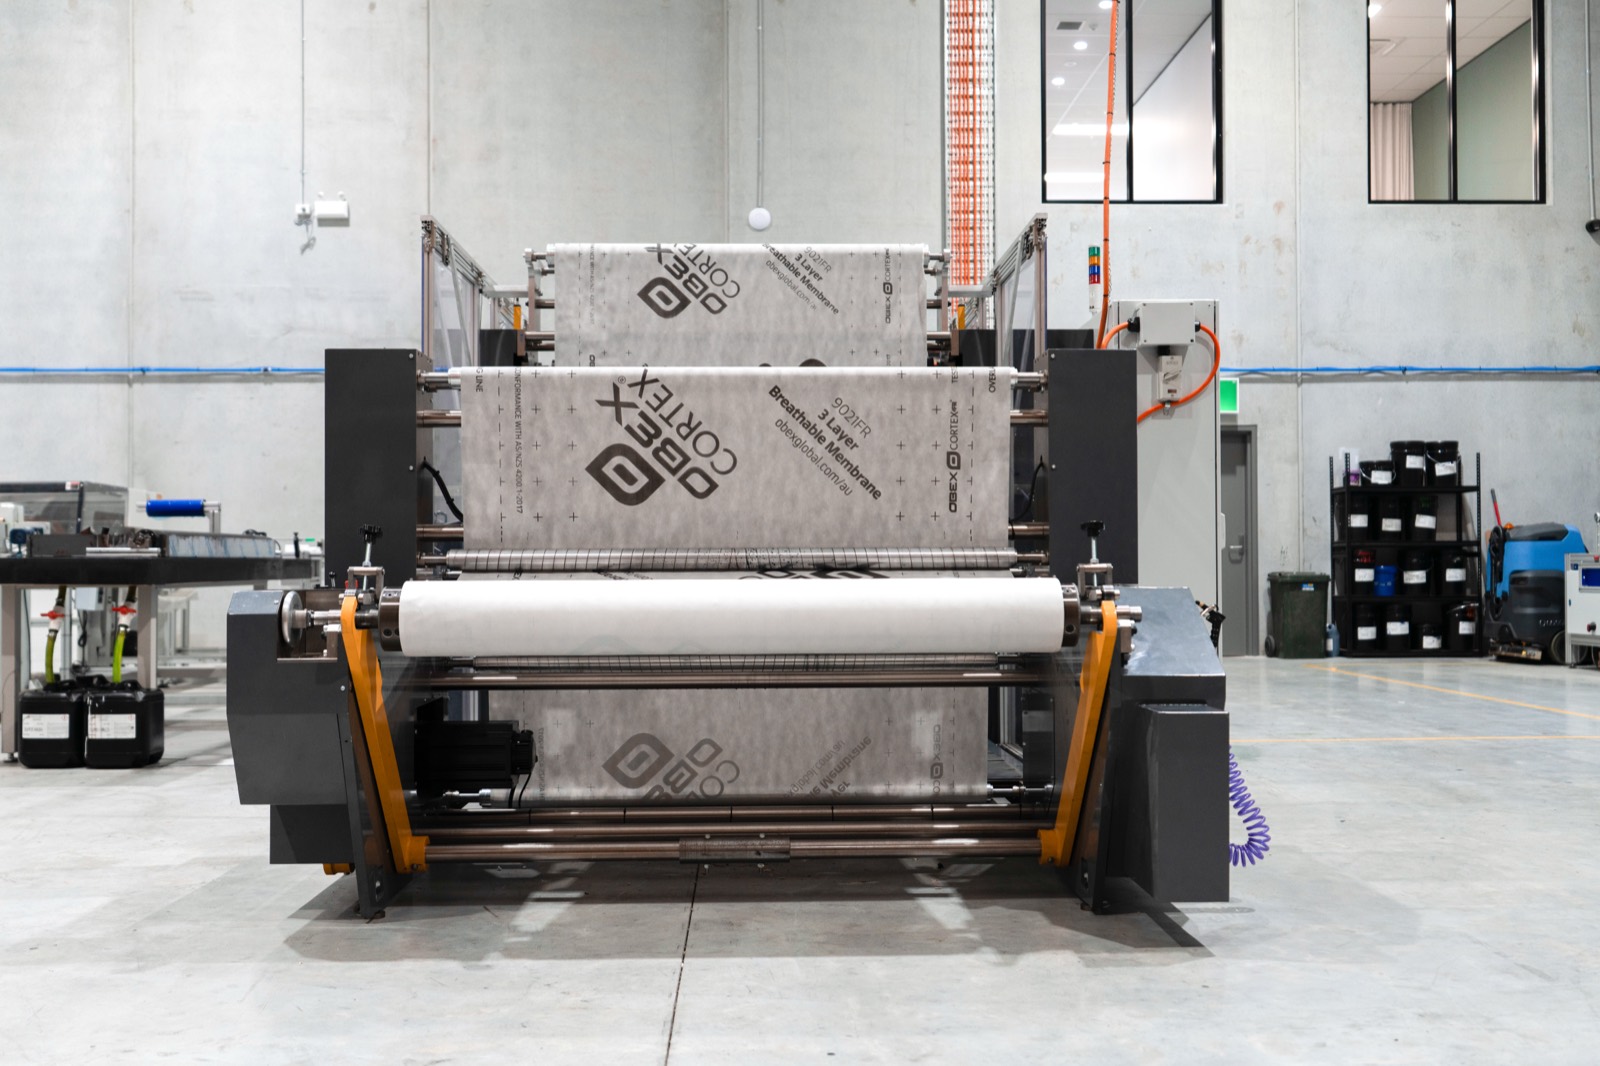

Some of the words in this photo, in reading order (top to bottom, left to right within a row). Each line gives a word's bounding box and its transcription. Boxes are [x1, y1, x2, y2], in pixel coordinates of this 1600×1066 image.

[644, 243, 728, 315] OBEX
[674, 243, 741, 299] CORTE
[793, 252, 803, 262] 3
[800, 259, 824, 282] Layer
[803, 246, 832, 274] 9021FR
[800, 276, 840, 316] Membrane
[475, 375, 484, 393] LINE
[514, 420, 522, 440] WITH
[816, 408, 828, 421] 3
[825, 416, 860, 451] Layer
[830, 396, 873, 440] 9021FR
[515, 440, 523, 468] AS/NZS
[595, 381, 719, 500] OBEX
[768, 384, 827, 446] Breathable
[824, 440, 882, 501] Membrane
[774, 416, 854, 497] obexglobal.com/au
[515, 469, 524, 515] 4200.1-2017
[949, 472, 958, 513] OBEX
